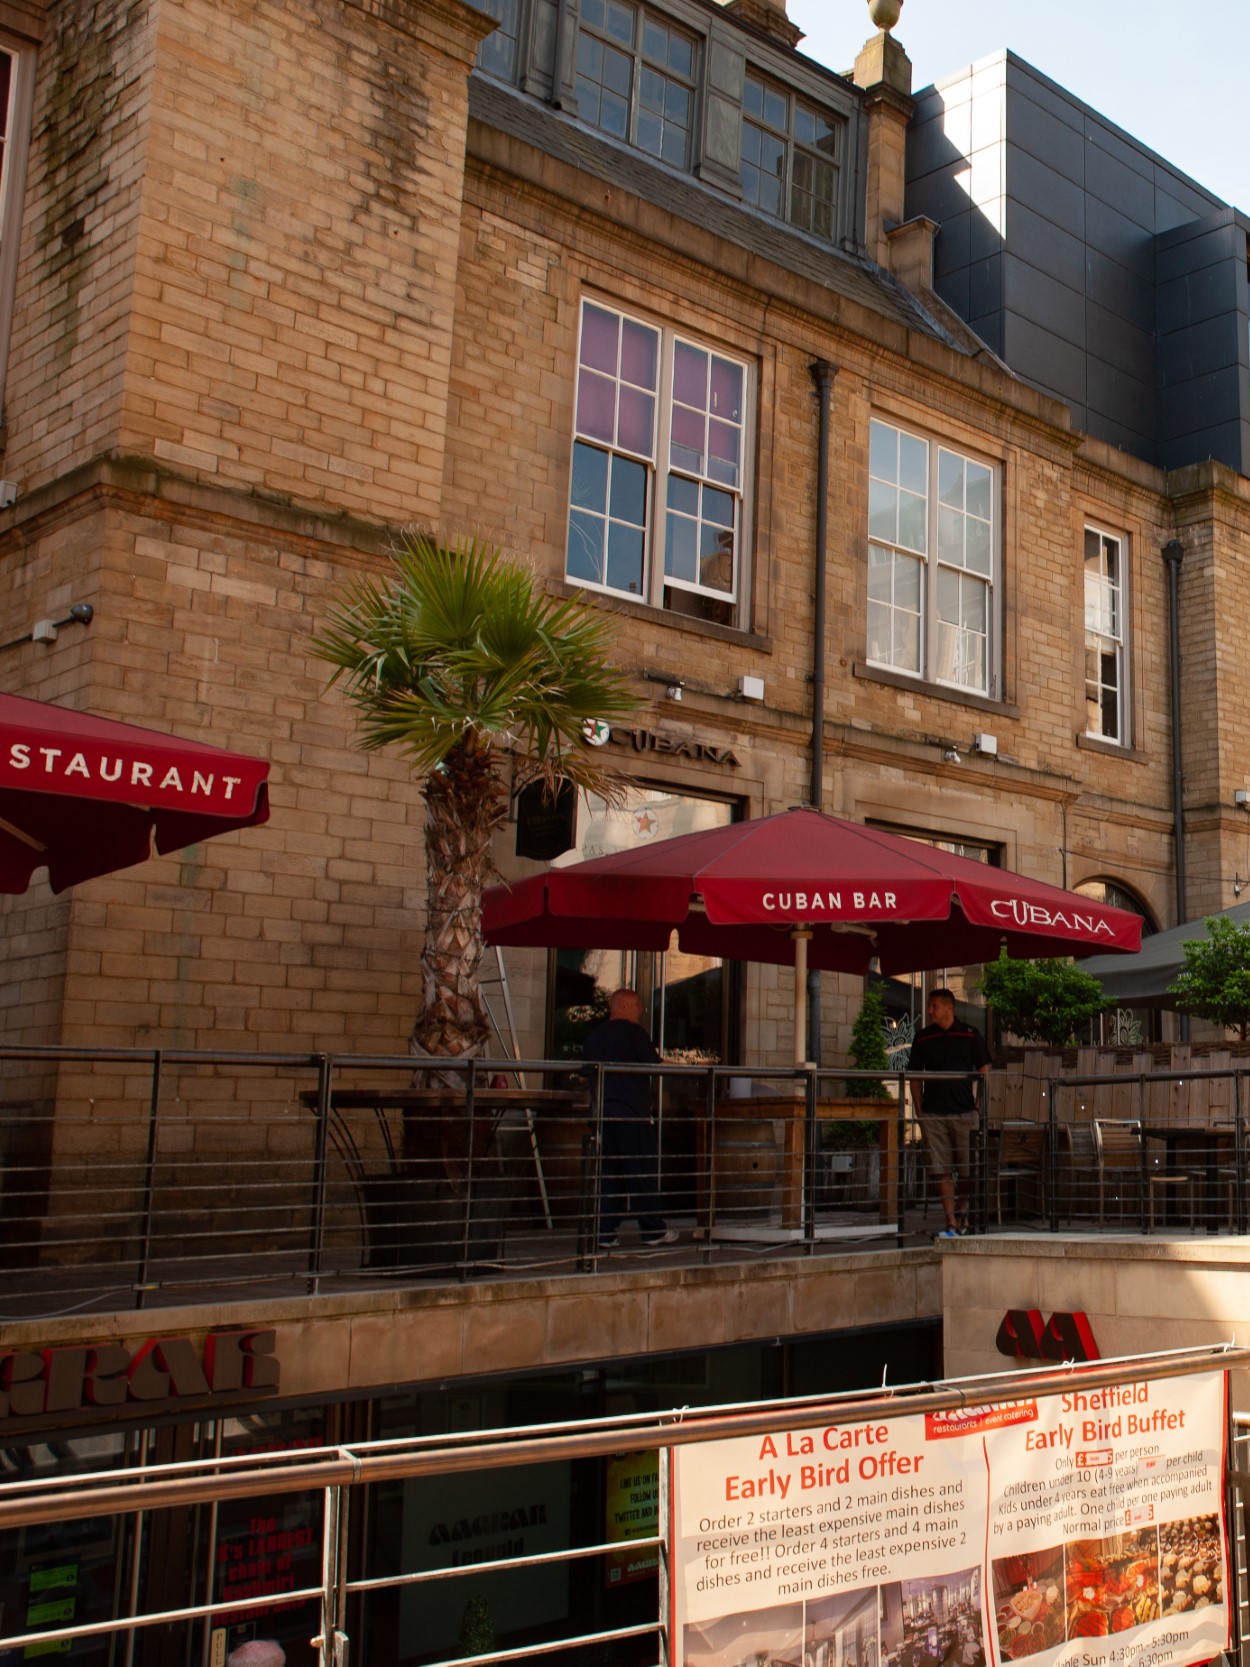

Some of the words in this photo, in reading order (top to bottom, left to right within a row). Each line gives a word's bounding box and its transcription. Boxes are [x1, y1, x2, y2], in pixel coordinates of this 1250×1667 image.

[762, 892, 842, 911] CUBAN
[853, 891, 898, 909] BAR
[990, 898, 1115, 937] CUBANA
[1062, 1382, 1148, 1413] Sheffield
[934, 1420, 977, 1434] restaurants
[986, 1415, 1002, 1425] event
[1004, 1409, 1033, 1422] catering
[1026, 1422, 1073, 1451] Early
[1082, 1416, 1121, 1442] Bird
[1128, 1409, 1185, 1434] Buffet
[759, 1436, 777, 1460] A
[787, 1432, 814, 1456] La
[823, 1424, 888, 1451] Carte
[1056, 1456, 1074, 1470] Only
[1115, 1450, 1127, 1462] per
[1130, 1445, 1159, 1458] person
[726, 1468, 791, 1501] Early
[800, 1459, 849, 1490] Bird
[859, 1451, 924, 1480] Offer
[999, 1502, 1017, 1516] Kids
[1020, 1496, 1052, 1511] under
[1055, 1492, 1059, 1503] 4
[1062, 1489, 1086, 1504] years
[1091, 1486, 1106, 1499] eat
[1109, 1479, 1124, 1495] free
[1127, 1475, 1148, 1490] when
[1151, 1465, 1207, 1486] accompanied
[1004, 1480, 1045, 1498] Children
[1049, 1474, 1073, 1488] under
[1077, 1470, 1091, 1482] 10
[1095, 1467, 1112, 1484] (4-9
[1166, 1455, 1181, 1469] per
[1183, 1450, 1203, 1465] child
[697, 1532, 749, 1552] receive
[754, 1525, 777, 1543] the
[781, 1518, 815, 1538] least
[819, 1510, 882, 1537] expensive
[886, 1505, 918, 1520] main
[924, 1499, 965, 1515] dishes
[699, 1512, 742, 1533] Order
[747, 1511, 755, 1526] 2
[759, 1504, 813, 1524] starters
[817, 1498, 841, 1515] and
[845, 1496, 852, 1511] 2
[857, 1492, 888, 1507] main
[892, 1485, 935, 1502] dishes
[939, 1480, 963, 1497] and
[994, 1522, 1004, 1535] by
[1007, 1522, 1012, 1531] a
[1017, 1514, 1052, 1532] paying
[1054, 1504, 1077, 1522] adult.
[1081, 1503, 1104, 1515] One
[1107, 1496, 1124, 1512] child
[1127, 1496, 1139, 1509] per
[1142, 1492, 1158, 1503] one
[1161, 1485, 1188, 1502] paying
[1191, 1479, 1212, 1494] adult
[1063, 1519, 1101, 1534] Normal
[1104, 1516, 1124, 1532] price
[696, 1573, 740, 1592] dishes
[745, 1565, 772, 1583] and
[777, 1558, 827, 1577] receive
[831, 1552, 852, 1568] the
[856, 1545, 886, 1564] least
[889, 1536, 956, 1562] expensive
[960, 1531, 967, 1545] 2
[705, 1554, 726, 1570] for
[730, 1546, 770, 1566] free!!
[775, 1540, 816, 1559] Order
[820, 1537, 828, 1550] 4
[832, 1530, 880, 1548] starters
[884, 1523, 908, 1539] and
[912, 1520, 920, 1534] 4
[925, 1517, 958, 1532] main
[778, 1580, 813, 1596] main
[818, 1572, 858, 1590] dishes
[862, 1562, 891, 1579] free.
[1083, 1654, 1106, 1666] Sun
[1110, 1644, 1143, 1662] 4:30pm
[1152, 1630, 1188, 1649] 5:30pm
[1139, 1650, 1173, 1667] 6:30pm
